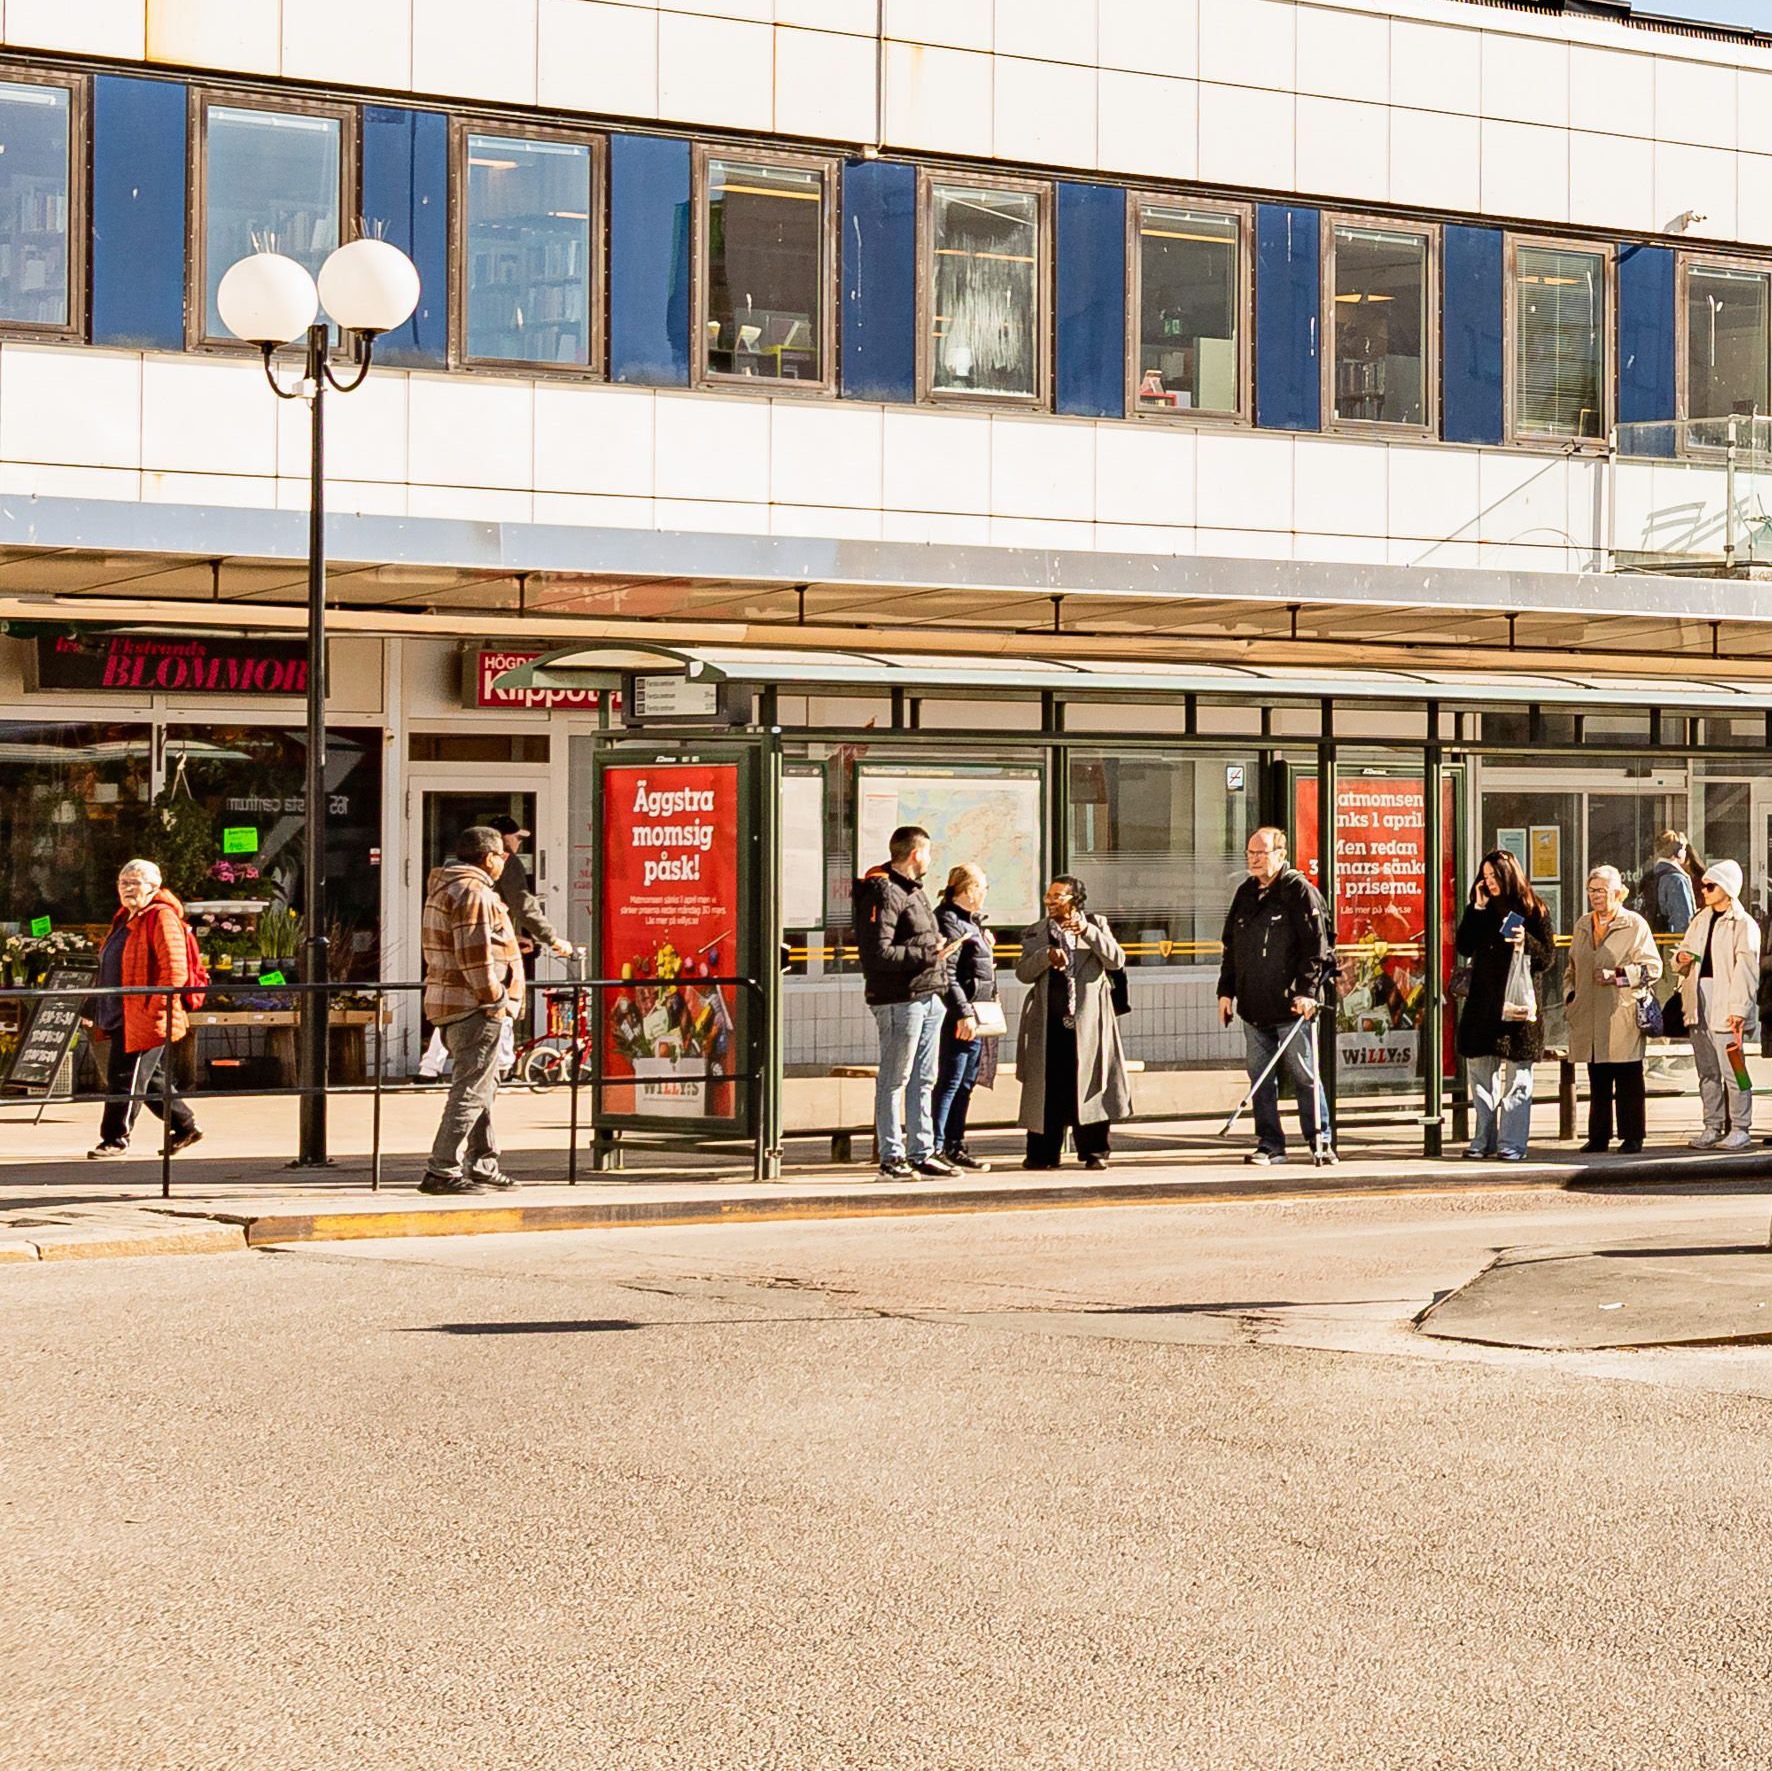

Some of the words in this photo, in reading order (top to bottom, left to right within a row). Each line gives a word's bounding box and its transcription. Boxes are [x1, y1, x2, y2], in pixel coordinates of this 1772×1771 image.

[632, 779, 715, 817] Äggstra
[1337, 791, 1425, 808] atmomsen
[1337, 811, 1369, 828] nks
[1371, 812, 1379, 828] 1
[1383, 811, 1426, 832] april.
[631, 818, 714, 851] momsig
[1370, 839, 1418, 856] redan
[643, 851, 701, 887] påsk!
[1337, 861, 1379, 876] mars
[1382, 857, 1426, 876] sänk
[1345, 877, 1422, 899] priserna.
[1354, 906, 1371, 914] mer
[1371, 905, 1383, 917] på
[1341, 1047, 1412, 1065] WiLLY:S
